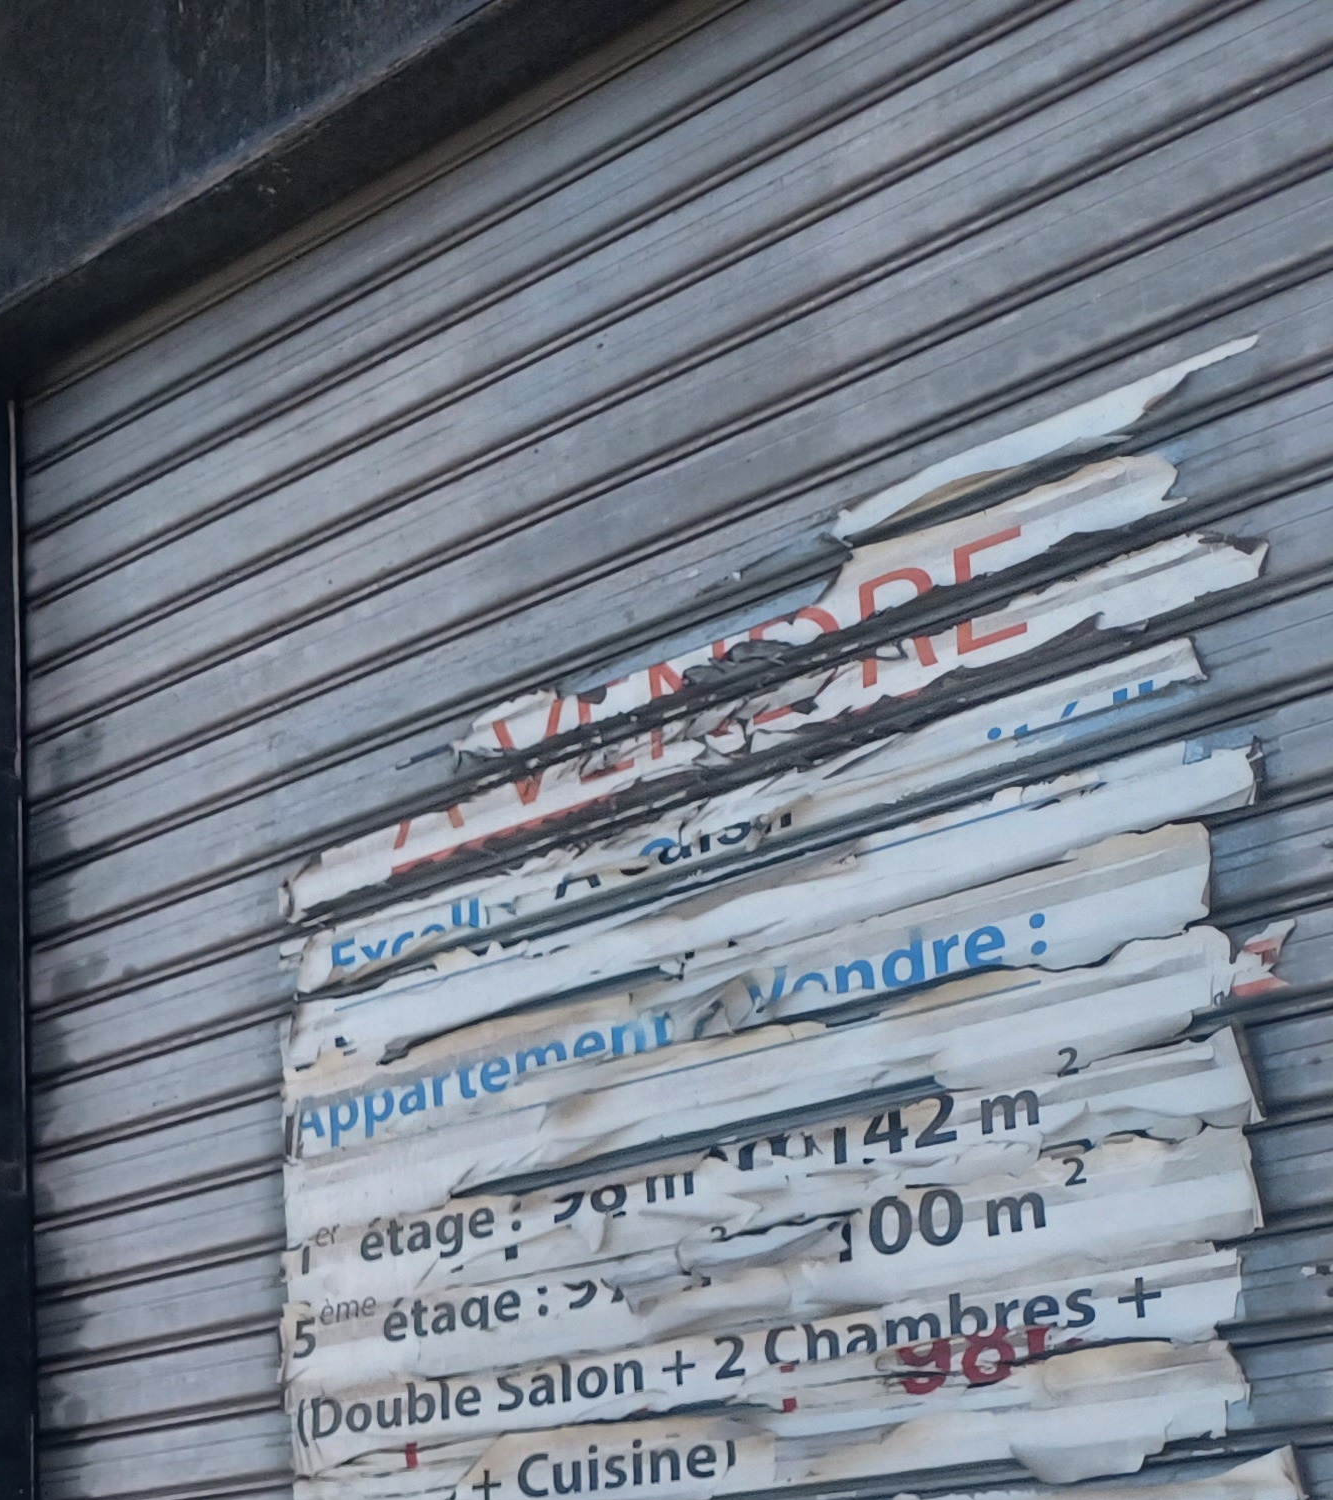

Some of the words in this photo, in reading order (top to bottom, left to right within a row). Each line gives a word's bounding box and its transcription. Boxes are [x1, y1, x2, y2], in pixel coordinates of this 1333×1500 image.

[300, 1013, 672, 1147] Appartement
[360, 1205, 495, 1262] étage
[296, 1381, 483, 1447] (Double
[497, 1361, 645, 1412] Salon
[714, 1335, 746, 1380] 2
[765, 1286, 1097, 1365] Chambres
